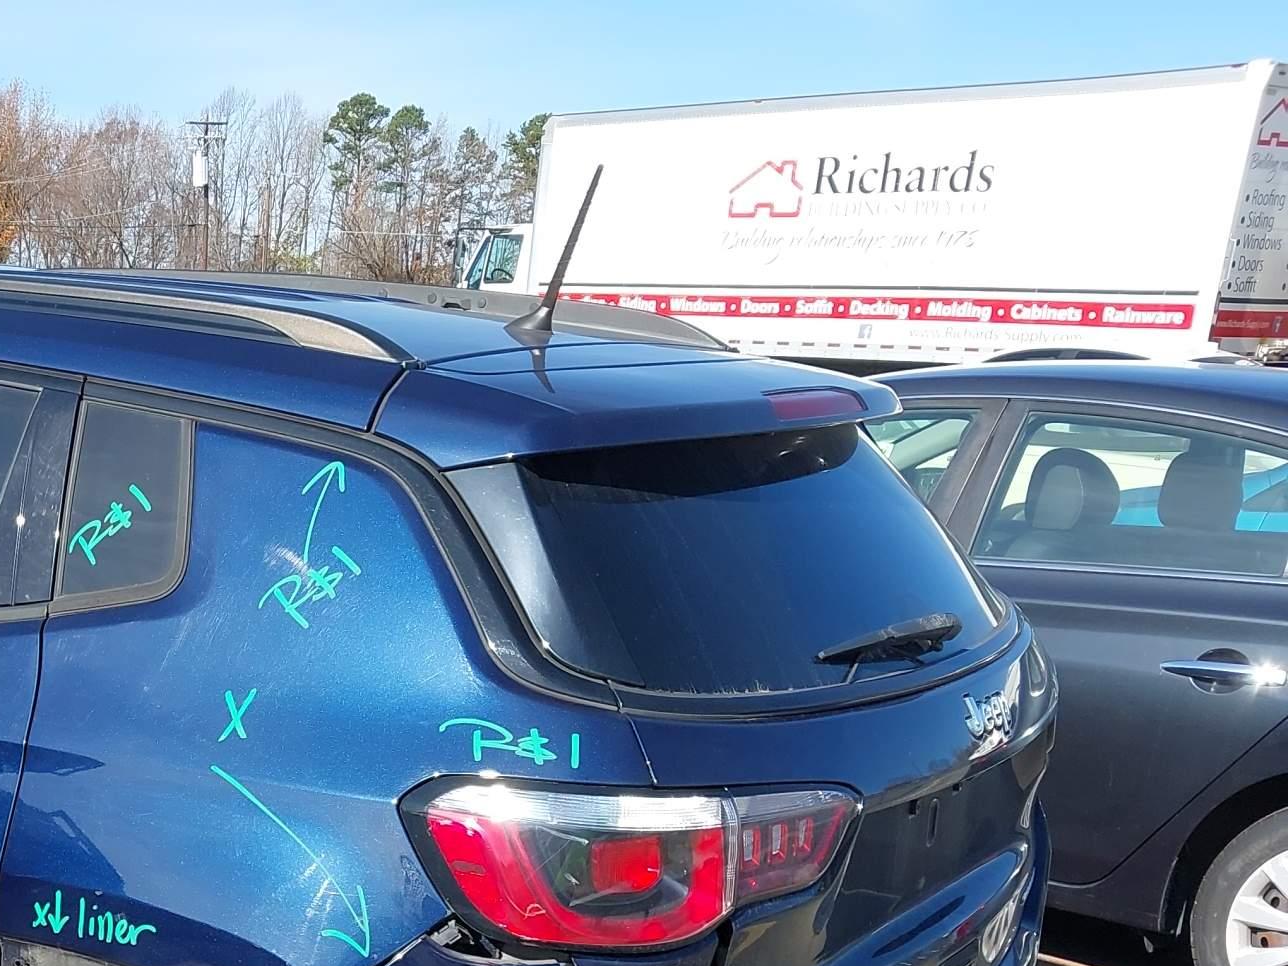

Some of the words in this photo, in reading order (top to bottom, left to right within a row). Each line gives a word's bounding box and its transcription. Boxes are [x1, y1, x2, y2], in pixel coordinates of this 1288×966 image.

[812, 150, 995, 195] Richards
[1252, 189, 1286, 212] Roofing
[1246, 211, 1275, 233] Siding
[1242, 233, 1283, 250] Windows
[1238, 255, 1265, 272] Doors
[1233, 276, 1257, 293] Soffit
[618, 296, 657, 313] Siding
[669, 296, 726, 314] Windows
[740, 299, 780, 314] Doors
[795, 298, 834, 315] Soffit
[849, 299, 909, 319] Decking
[926, 301, 993, 322] Molding
[1010, 302, 1083, 322] Cabinets
[1101, 305, 1185, 325] Rainware
[962, 690, 1012, 738] Jeep
[77, 896, 157, 946] liner
